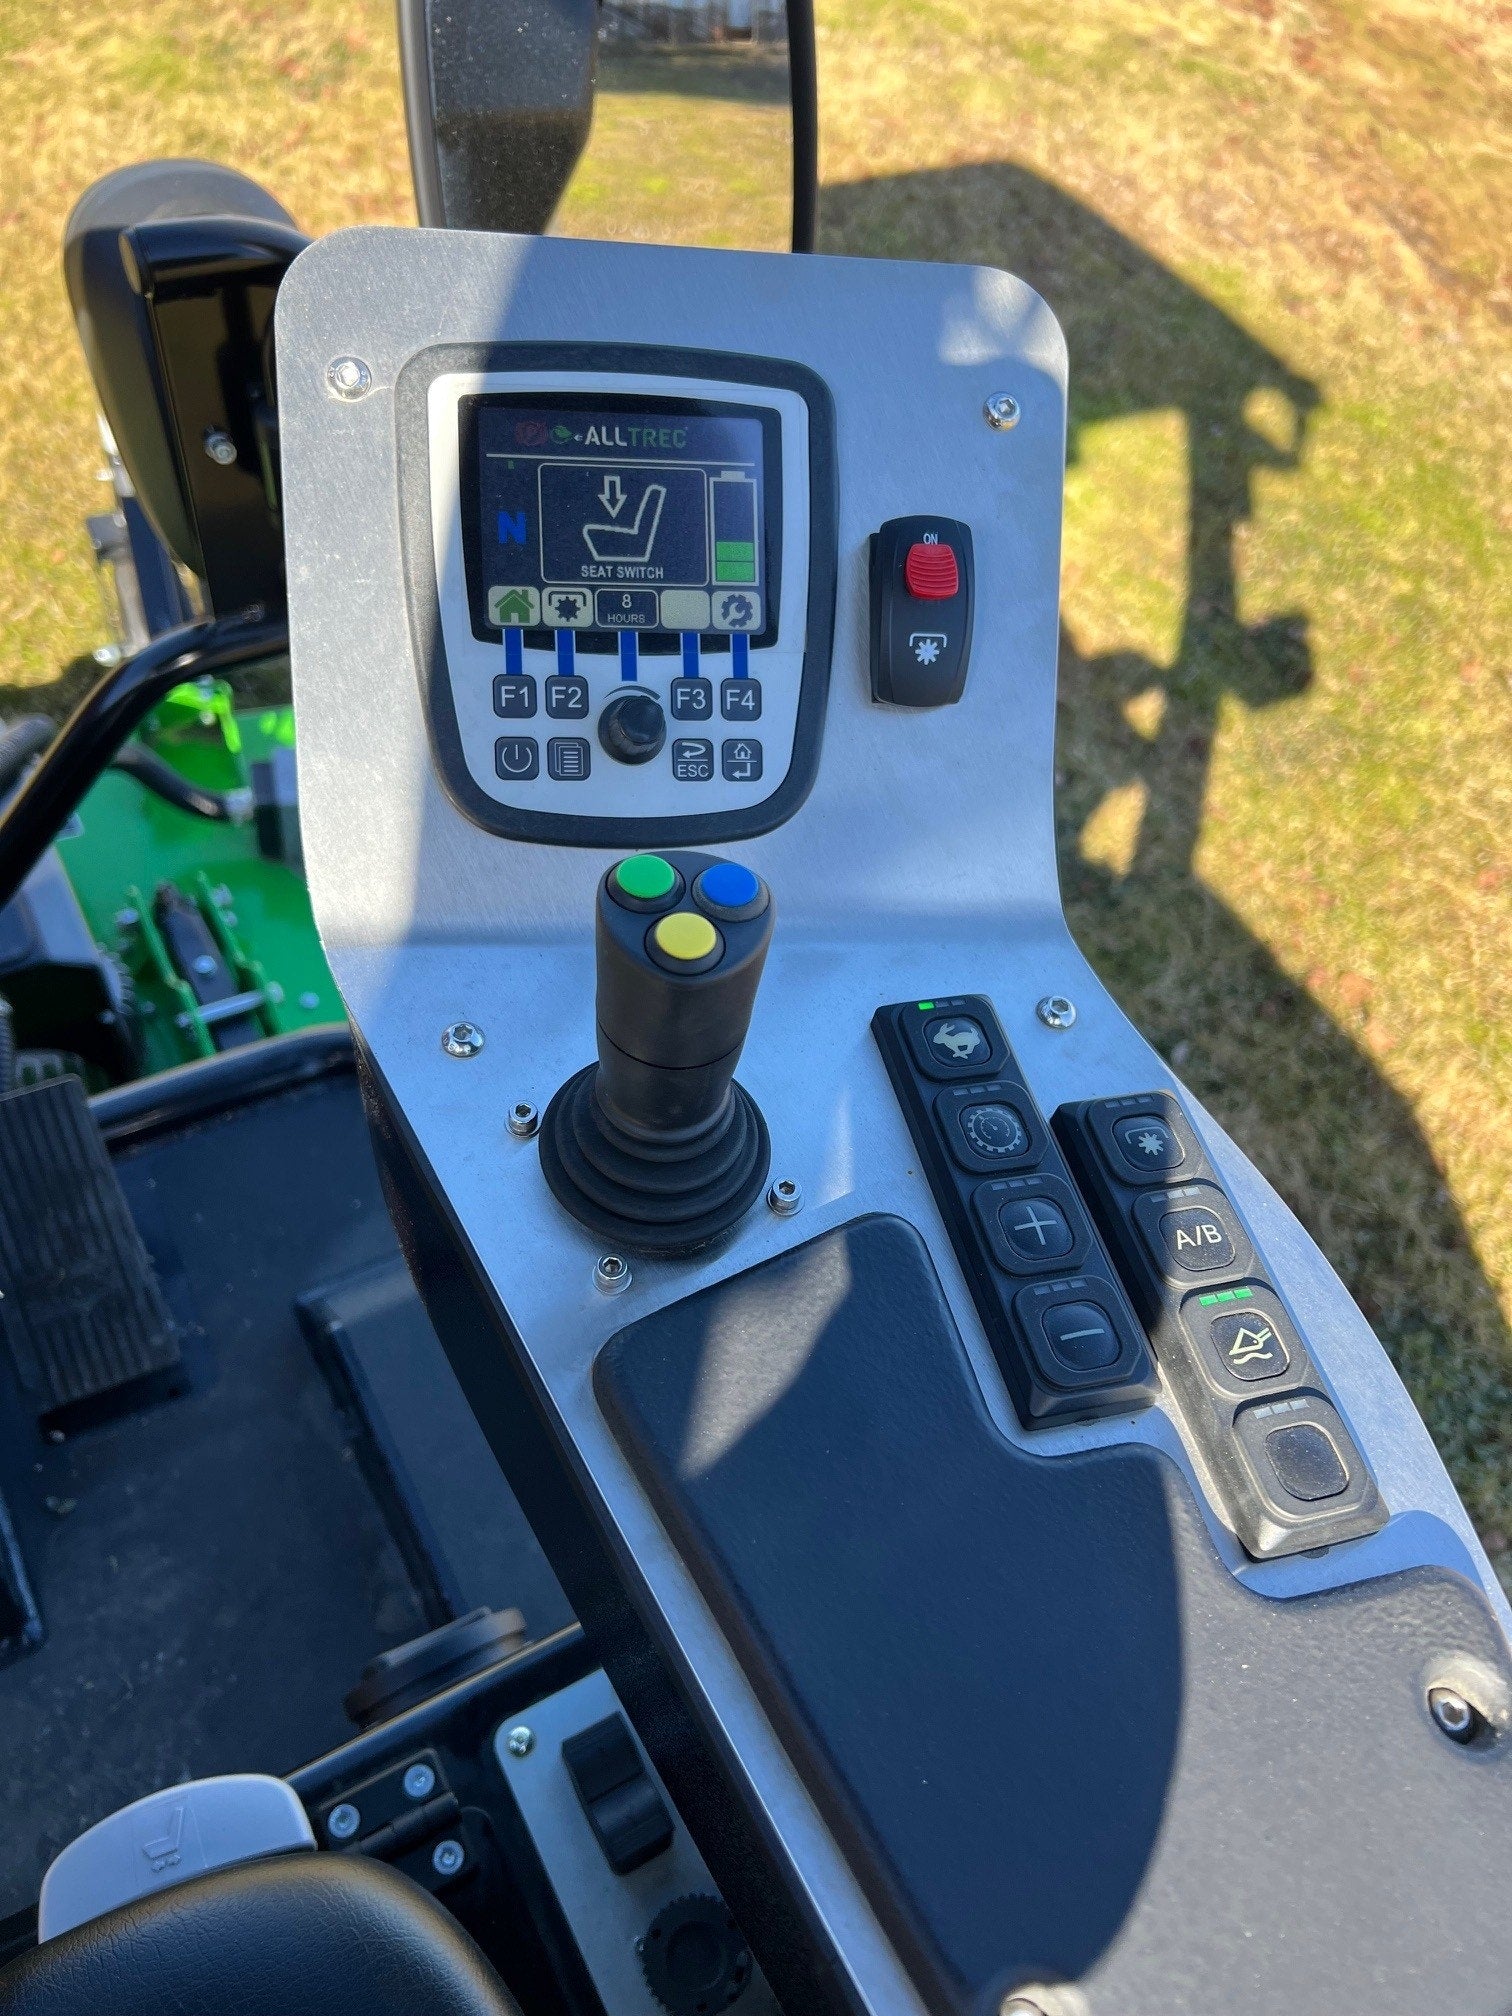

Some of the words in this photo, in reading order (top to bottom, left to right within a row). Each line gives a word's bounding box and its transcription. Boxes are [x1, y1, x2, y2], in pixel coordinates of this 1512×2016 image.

[584, 425, 688, 449] ALLTREC
[497, 511, 527, 544] N
[923, 532, 939, 545] ON
[581, 565, 612, 578] SEAT
[616, 566, 664, 579] SWITCH
[622, 594, 633, 608] 8
[607, 613, 646, 624] HOURS
[501, 686, 529, 708] F1
[551, 686, 583, 708] F2
[677, 688, 706, 710] F3
[726, 689, 755, 711] F4
[677, 764, 709, 778] ESC
[1176, 1224, 1222, 1250] A/B
